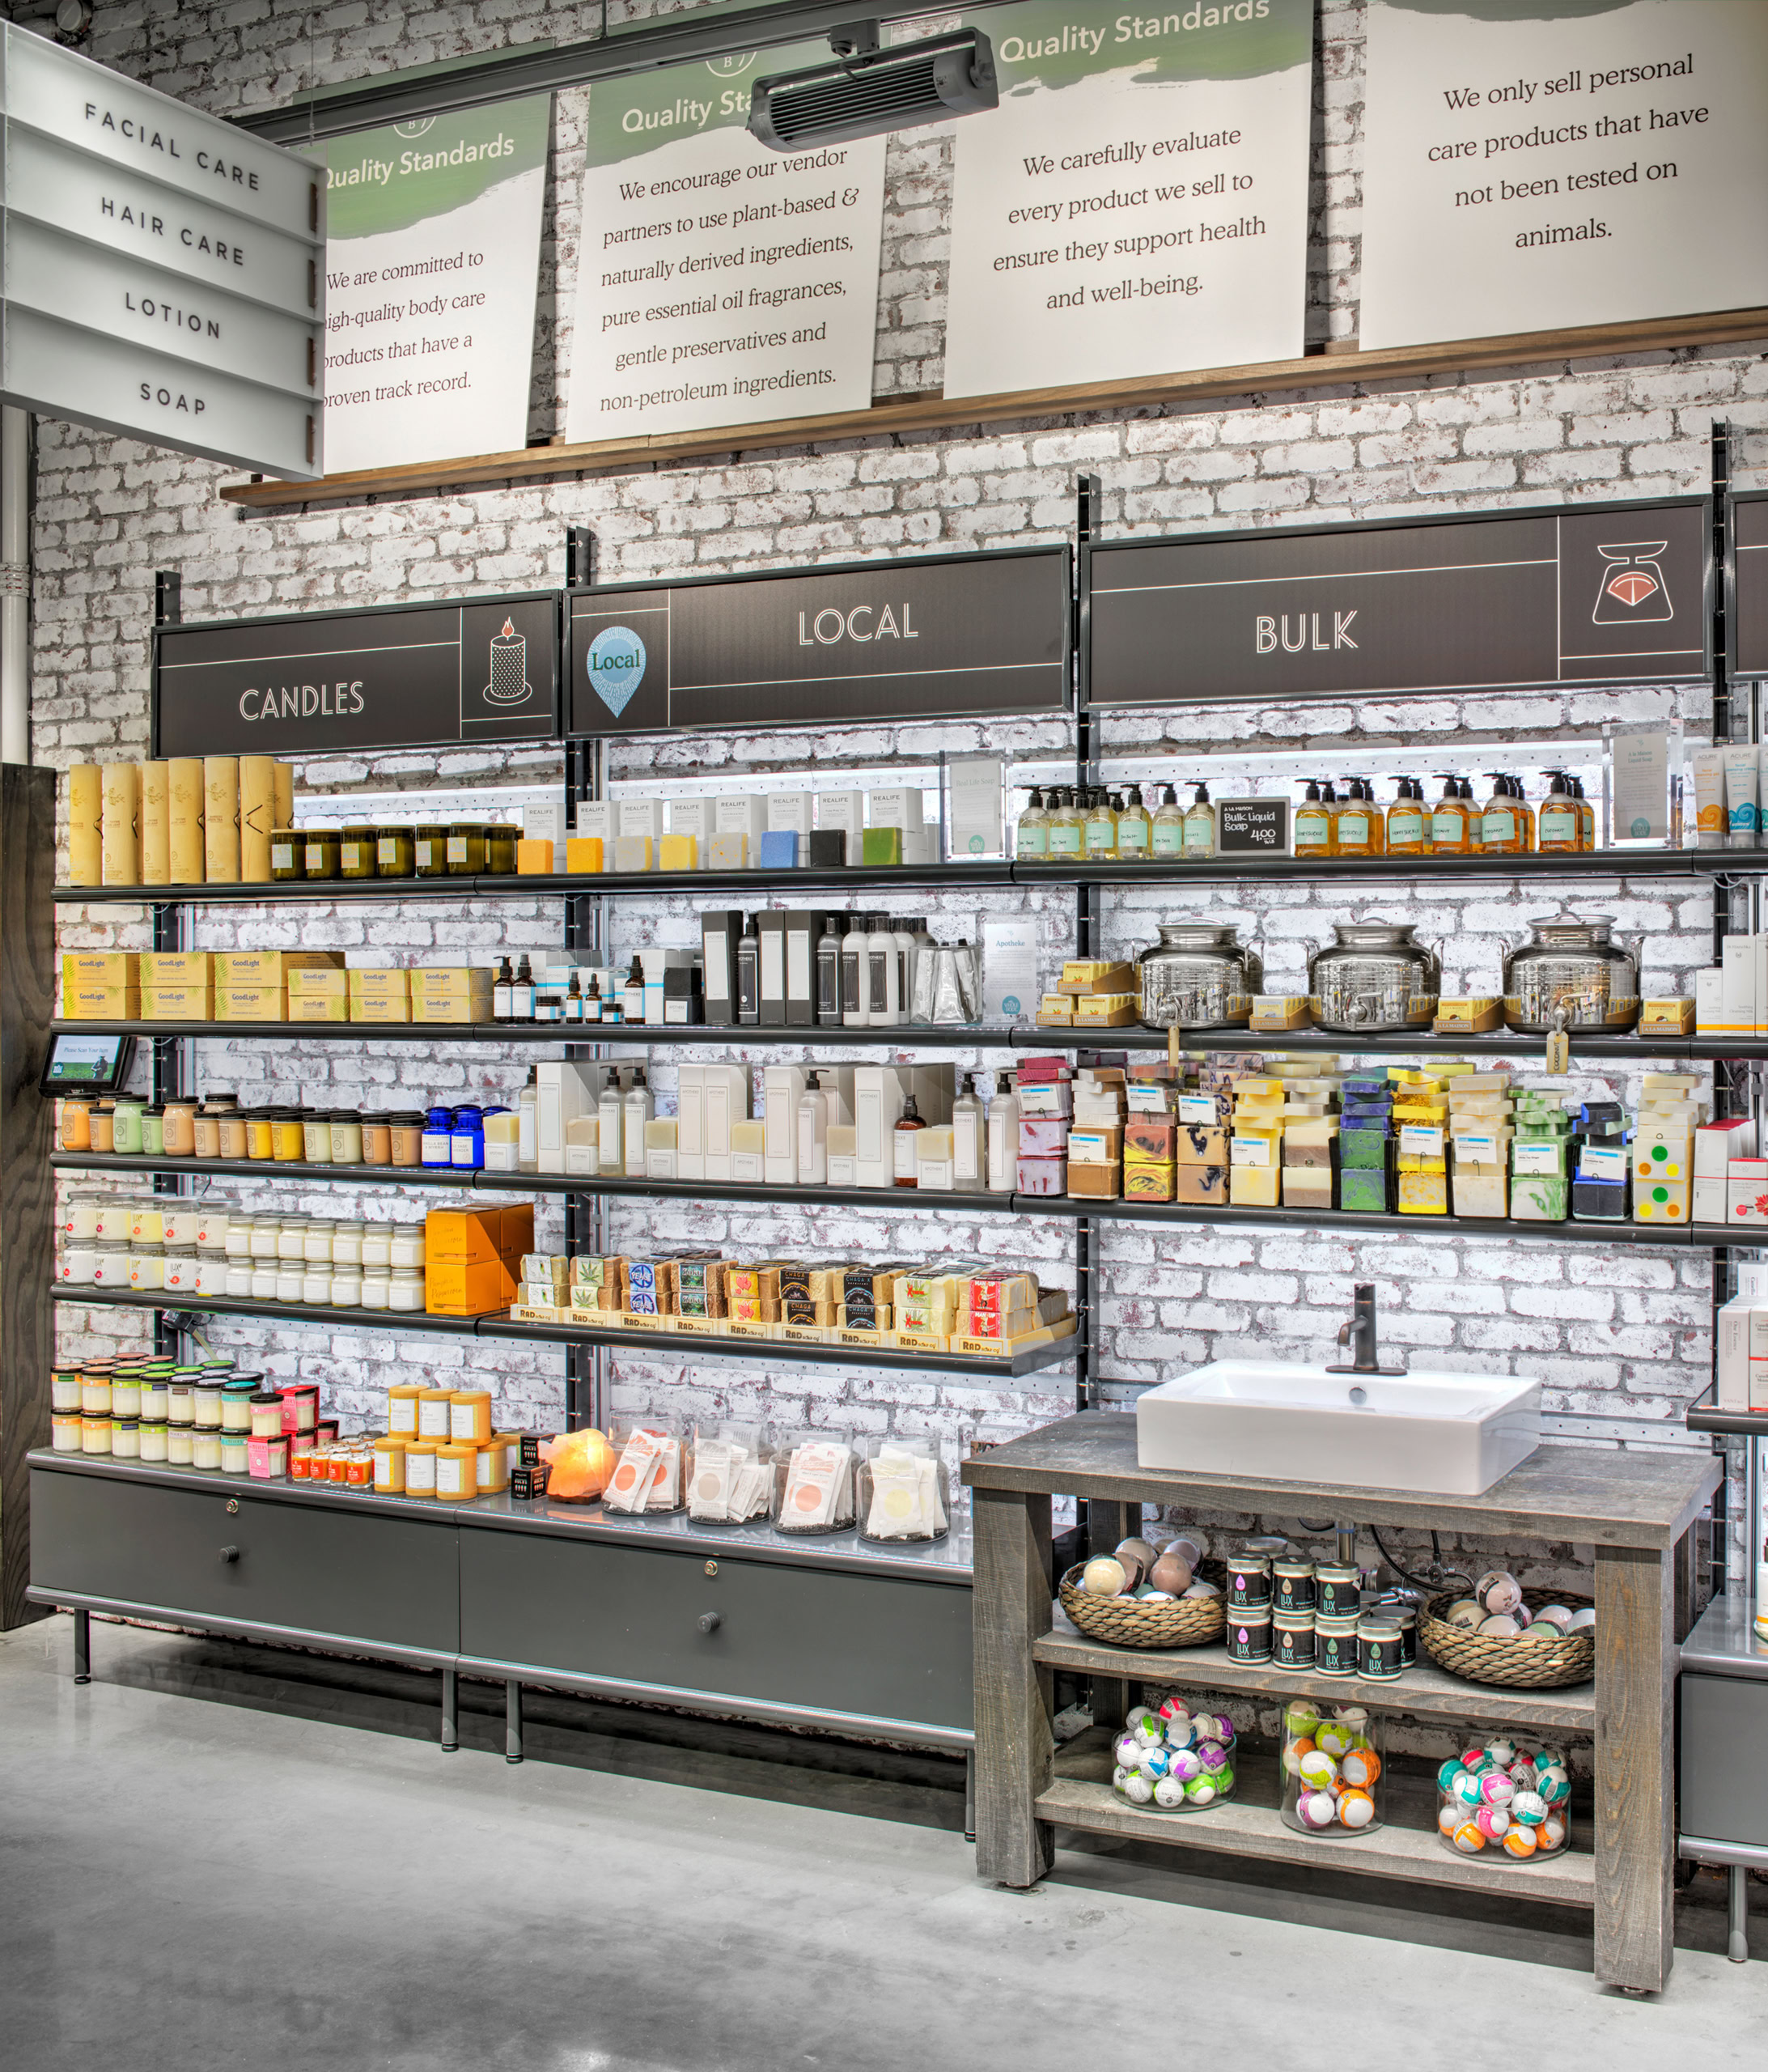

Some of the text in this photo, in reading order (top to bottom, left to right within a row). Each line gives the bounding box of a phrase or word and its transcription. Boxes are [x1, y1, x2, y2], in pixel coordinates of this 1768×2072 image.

[1000, 0, 1269, 62] Quality Standards
[1444, 53, 1693, 109] We only sell personal
[622, 99, 713, 132] Quality
[86, 103, 258, 191] FACIAL CARE
[1428, 108, 1708, 161] care products that have
[400, 133, 514, 174] Standards
[1023, 130, 1240, 176] We carefully evaluate
[620, 150, 847, 200] We encourage our vendor
[1456, 162, 1677, 206] not been tested on
[1009, 174, 1253, 223] every product we sell to
[102, 197, 244, 265] HAIR CARE
[604, 189, 859, 248] partners to use plant-based &
[1516, 218, 1612, 248] animals.
[994, 216, 1266, 270] ensure they support health
[327, 252, 483, 289] We are committed to
[602, 236, 852, 286] naturally derived ingredients,
[602, 282, 846, 332] pure essential oil fragrances,
[1047, 275, 1202, 308] and well-being.
[126, 292, 219, 339] LOTION
[325, 293, 485, 332] igh-quality body care
[388, 342, 417, 359] that
[422, 338, 458, 354] have
[464, 336, 472, 347] a
[616, 322, 825, 371] gentle preservatives and
[141, 383, 205, 414] SOAP
[376, 380, 412, 400] track
[418, 372, 471, 394] record.
[600, 370, 836, 411] non-petroleum ingredients.
[799, 603, 918, 645] LOCAL
[1257, 611, 1358, 653] BULK
[592, 649, 640, 670] Local
[240, 681, 364, 720] CANDLES
[1224, 811, 1275, 823] Bulk Liquid
[1224, 822, 1248, 832] Soap
[520, 1310, 536, 1318] RAD
[573, 1314, 587, 1323] RAD
[625, 1318, 639, 1327] RAD
[677, 1321, 693, 1331] RAD
[731, 1326, 747, 1334] RAD
[786, 1330, 802, 1339] RAD
[842, 1334, 859, 1343] RAD
[900, 1337, 918, 1345] RAD
[963, 1341, 981, 1350] RAD
[1235, 1590, 1246, 1603] LUX
[1281, 1594, 1293, 1606] LUX
[1324, 1599, 1335, 1612] LUX
[1236, 1643, 1249, 1655] LUX
[1282, 1648, 1293, 1660] LUX
[1326, 1654, 1338, 1667] LUX
[1369, 1659, 1382, 1672] LUX
